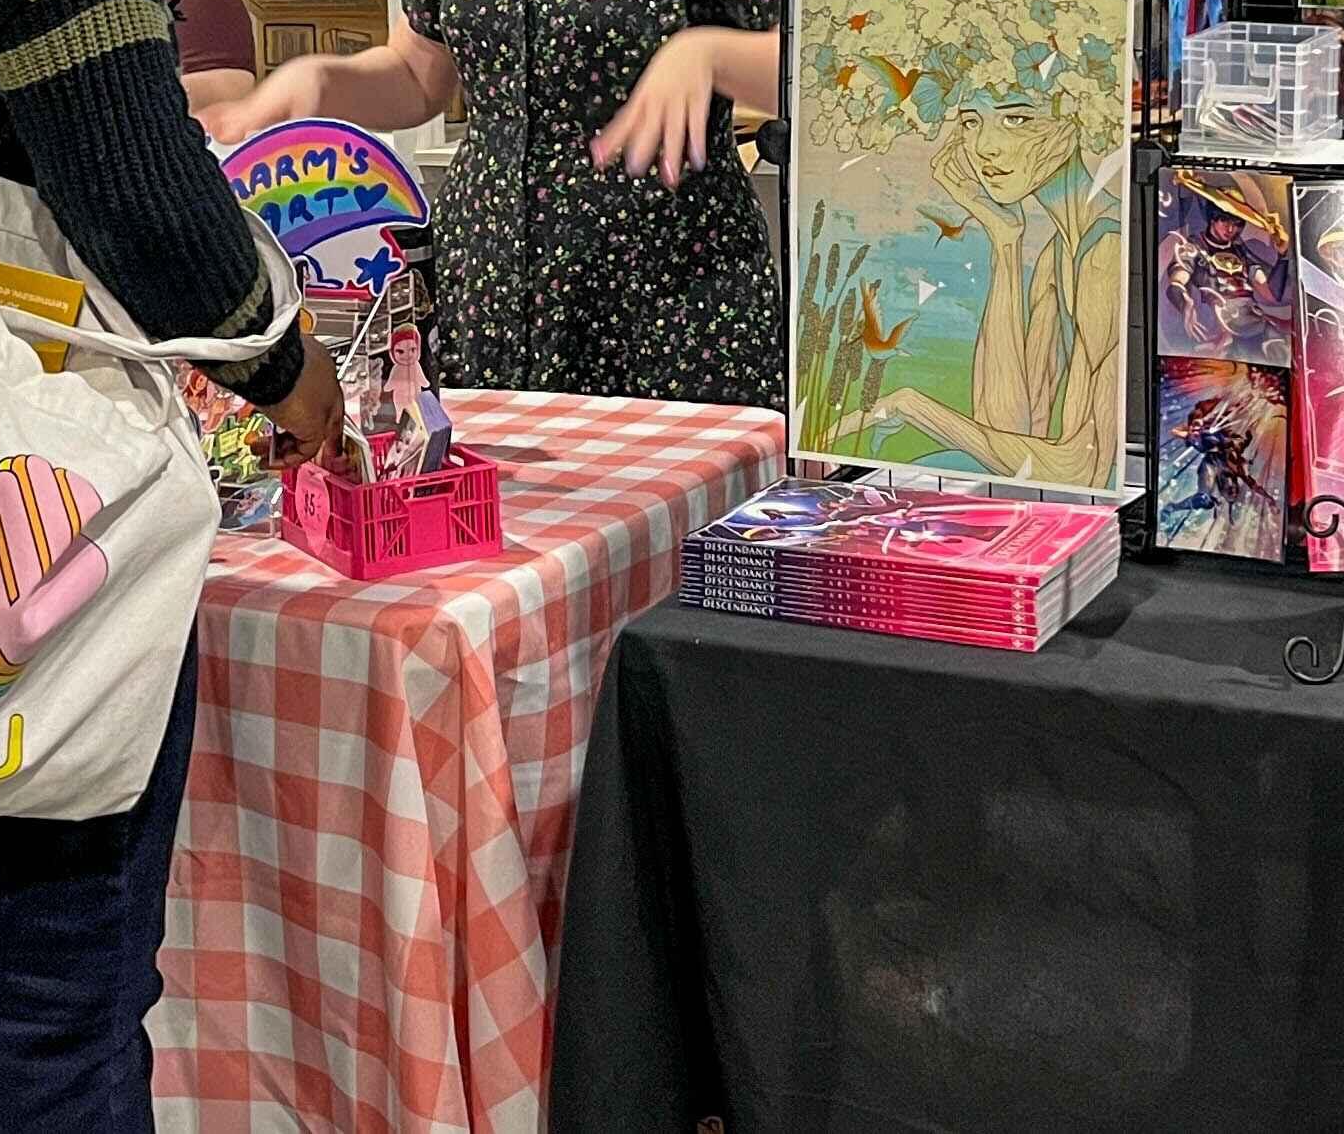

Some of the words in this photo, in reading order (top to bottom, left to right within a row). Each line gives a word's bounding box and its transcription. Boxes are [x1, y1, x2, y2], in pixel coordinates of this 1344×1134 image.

[704, 542, 776, 557] DESCENDANCY
[703, 553, 775, 568] DESCENDANCY
[704, 564, 775, 580] DESCENDANCY
[704, 576, 775, 592] DESCENDANCY
[704, 587, 776, 604] DESCENDANCY
[702, 599, 774, 616] DESCENDANCY
